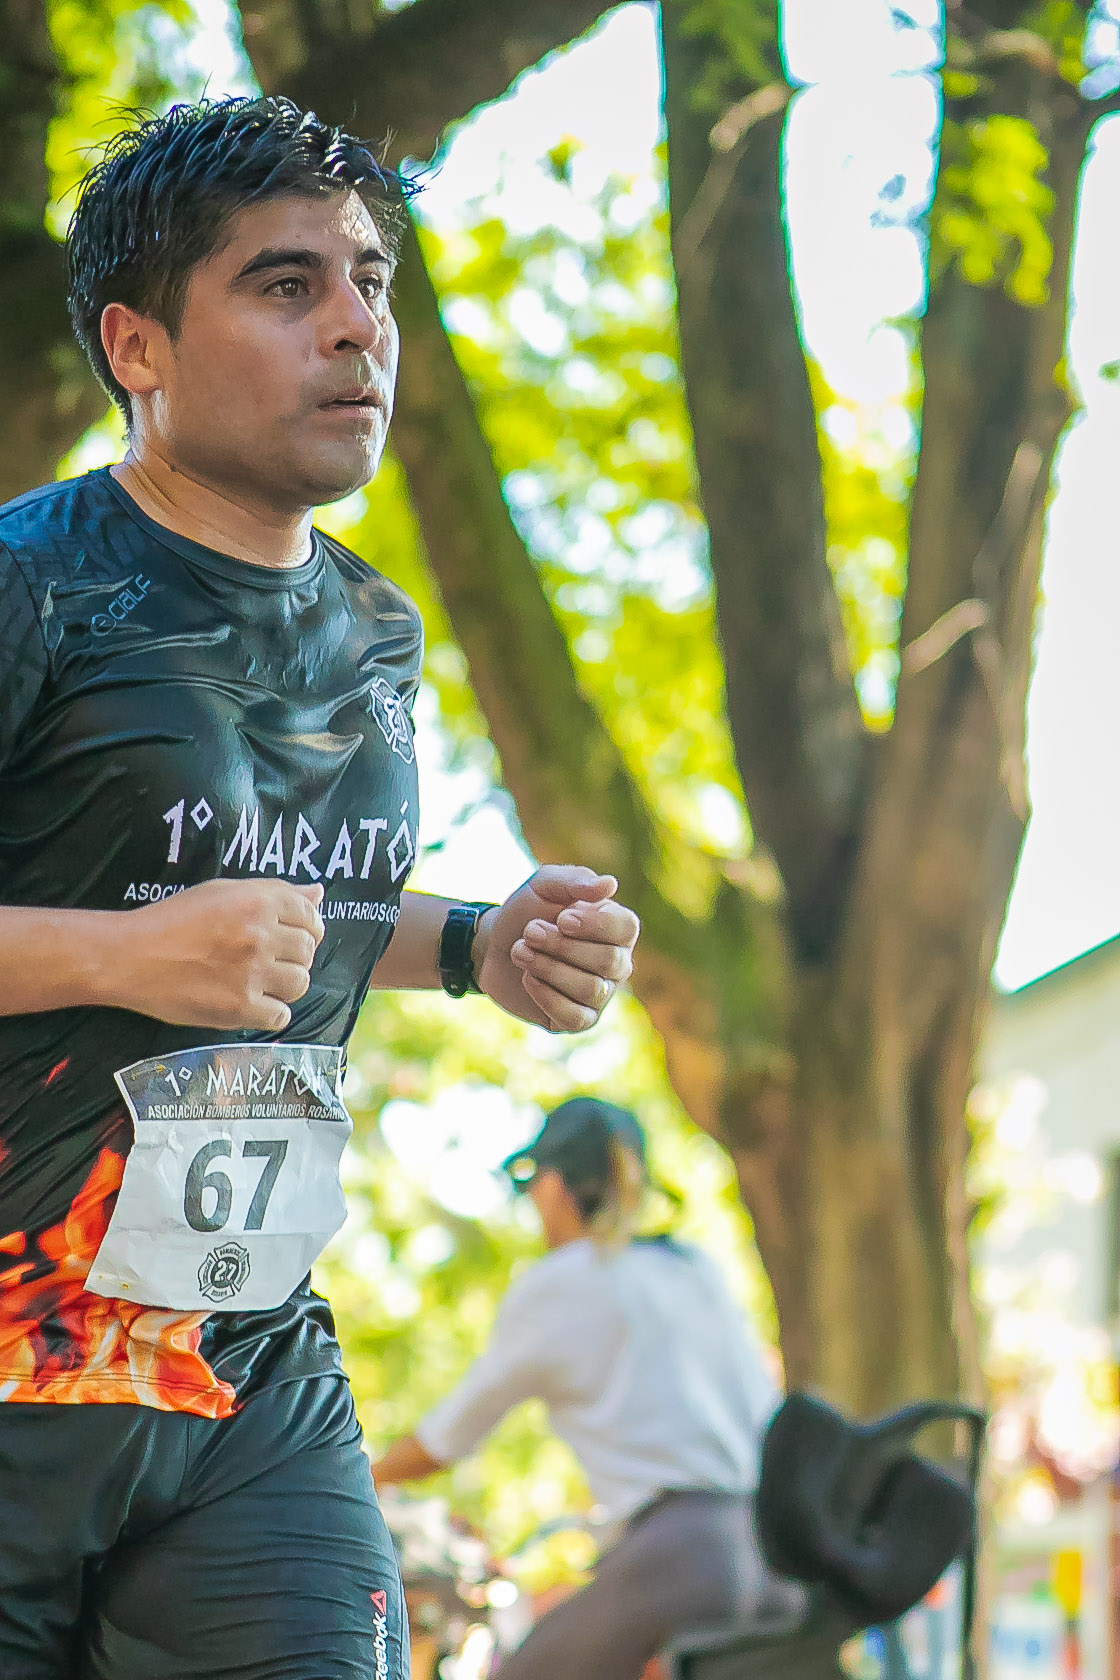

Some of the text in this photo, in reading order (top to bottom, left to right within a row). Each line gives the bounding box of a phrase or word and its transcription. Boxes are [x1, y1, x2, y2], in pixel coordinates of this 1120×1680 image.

[222, 799, 418, 883] MARATÓ
[317, 900, 387, 922] LUNTARIOS
[205, 1103, 251, 1119] BOMBEROS
[251, 1102, 307, 1118] VOLUNTARIOS
[183, 1138, 289, 1233] 67
[214, 1260, 237, 1282] 27
